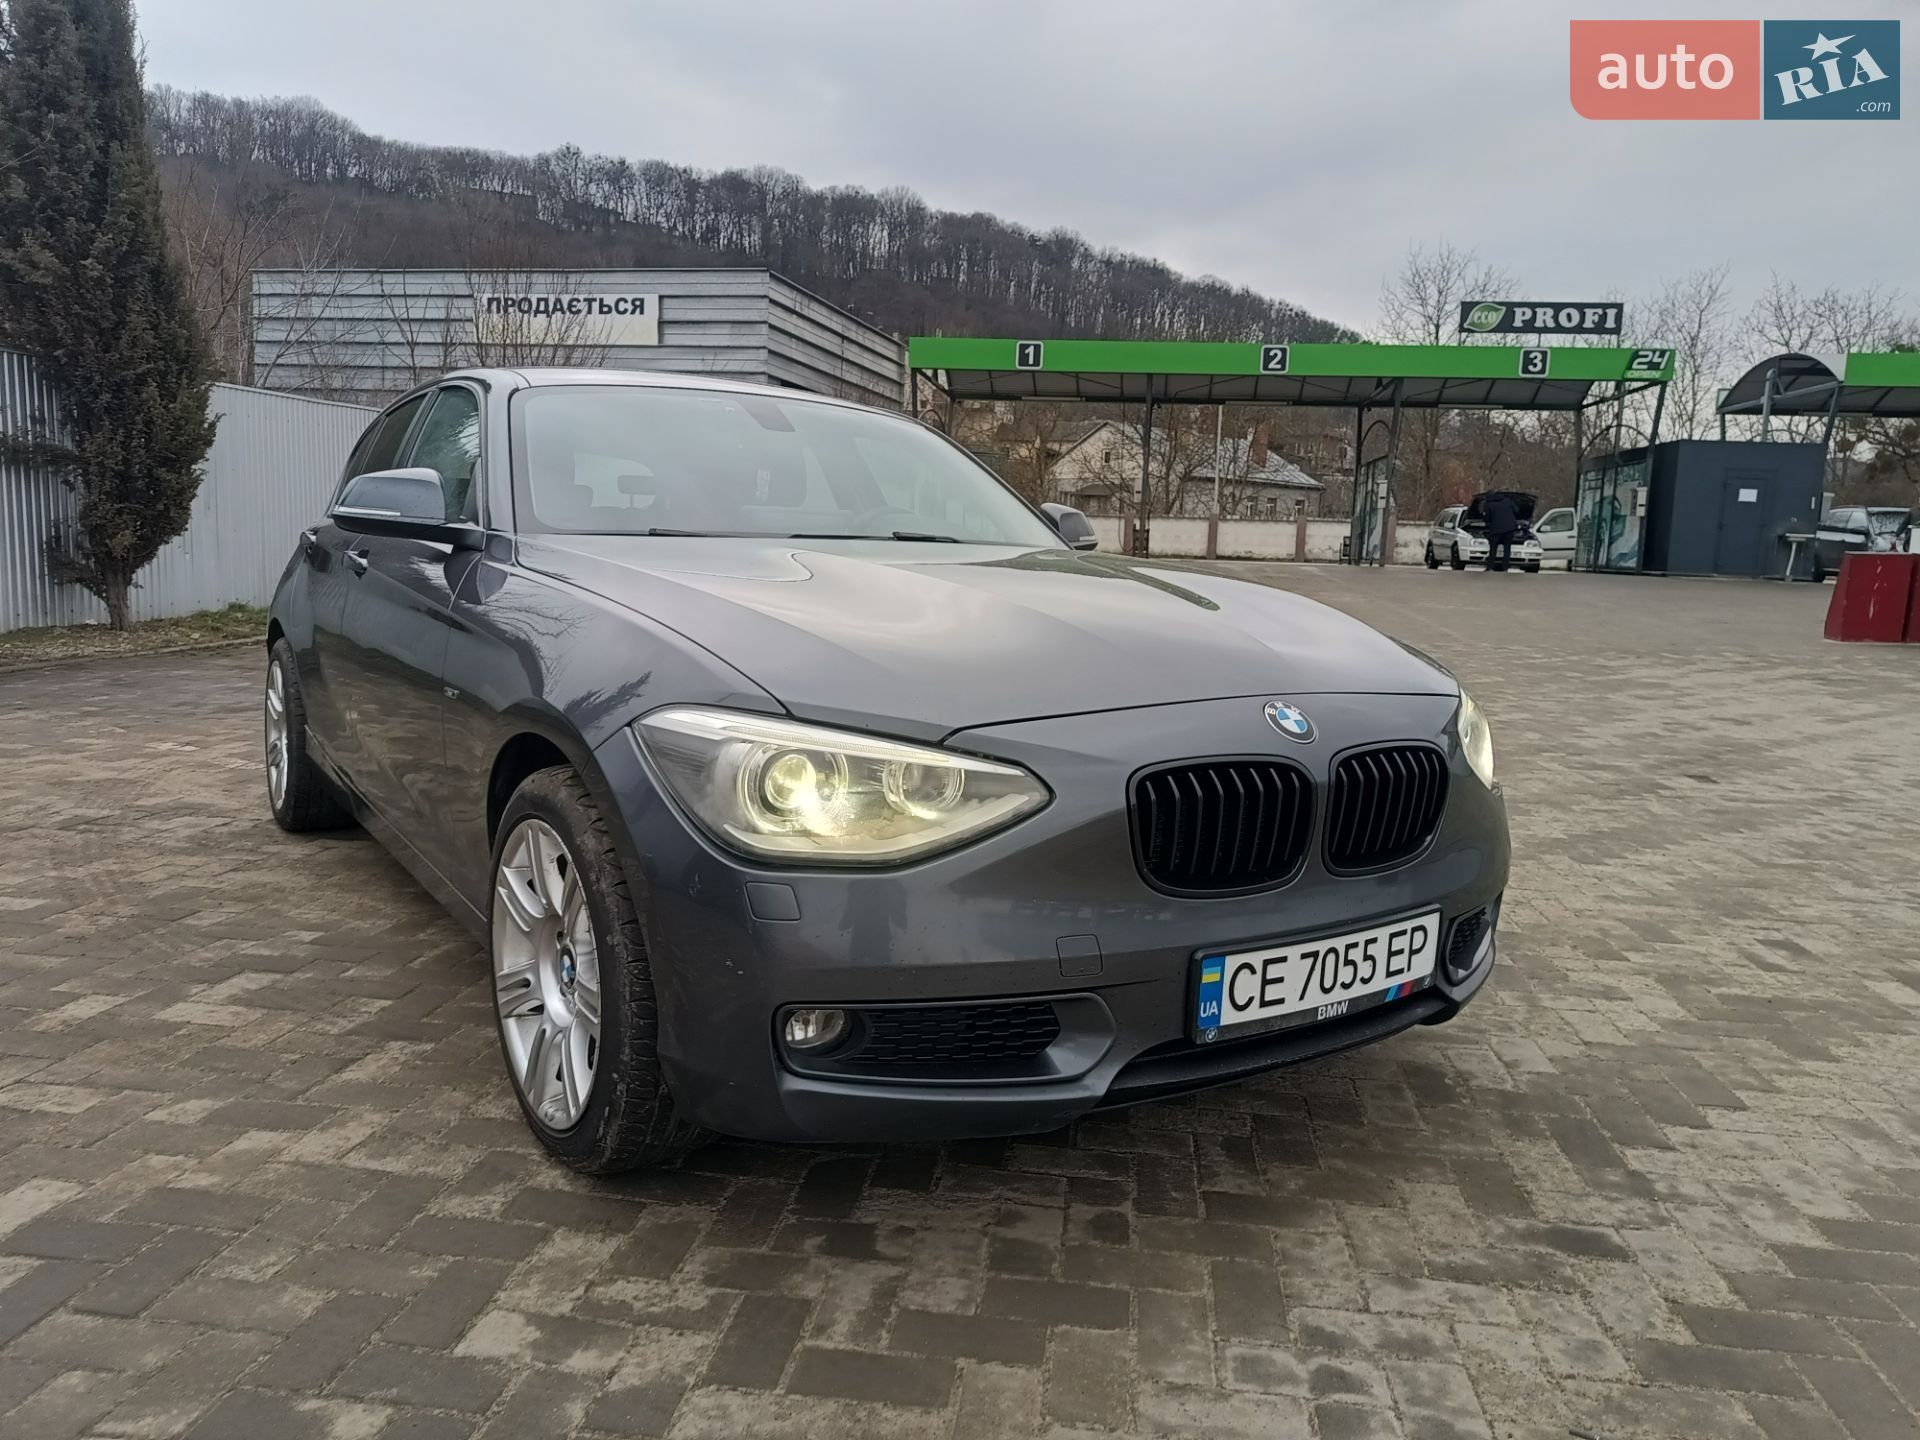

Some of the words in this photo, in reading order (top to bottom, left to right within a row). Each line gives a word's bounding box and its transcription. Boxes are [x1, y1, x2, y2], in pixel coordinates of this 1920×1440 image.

[486, 297, 644, 318] ПРОДАЄТЬСЯ
[1473, 310, 1496, 323] eco
[1512, 308, 1618, 328] PROFI
[1024, 345, 1036, 365] 1
[1267, 349, 1282, 369] 2
[1528, 352, 1543, 372] 3
[1631, 351, 1671, 370] 24
[1267, 702, 1301, 715] BMW
[1228, 955, 1289, 1012] CE
[1298, 936, 1379, 1002] 7055
[1385, 924, 1429, 979] EP
[1200, 1002, 1218, 1018] UA
[1317, 1000, 1349, 1020] BMW
